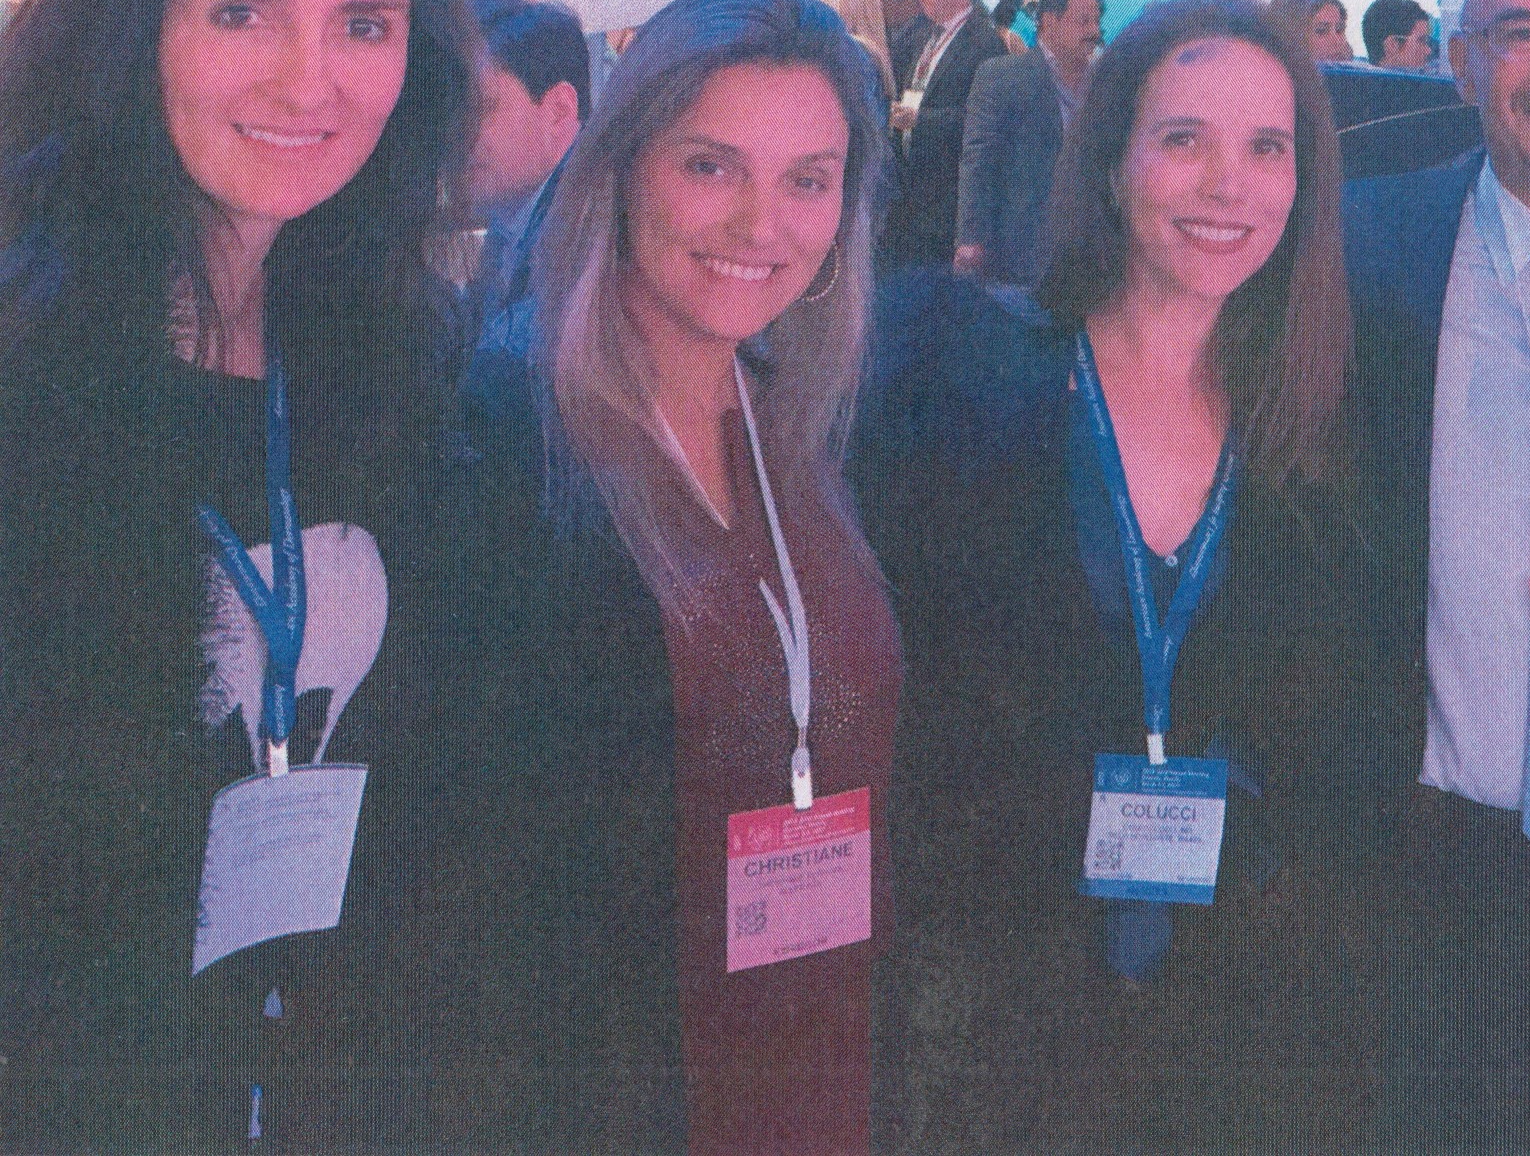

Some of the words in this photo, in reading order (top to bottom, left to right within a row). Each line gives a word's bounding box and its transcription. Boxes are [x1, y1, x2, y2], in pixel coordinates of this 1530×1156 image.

[1186, 525, 1214, 579] Dermatology
[283, 566, 299, 611] Academy
[1129, 556, 1148, 594] Academy
[1121, 802, 1197, 822] COLUCCI
[743, 841, 853, 878] CHRISTIANE
